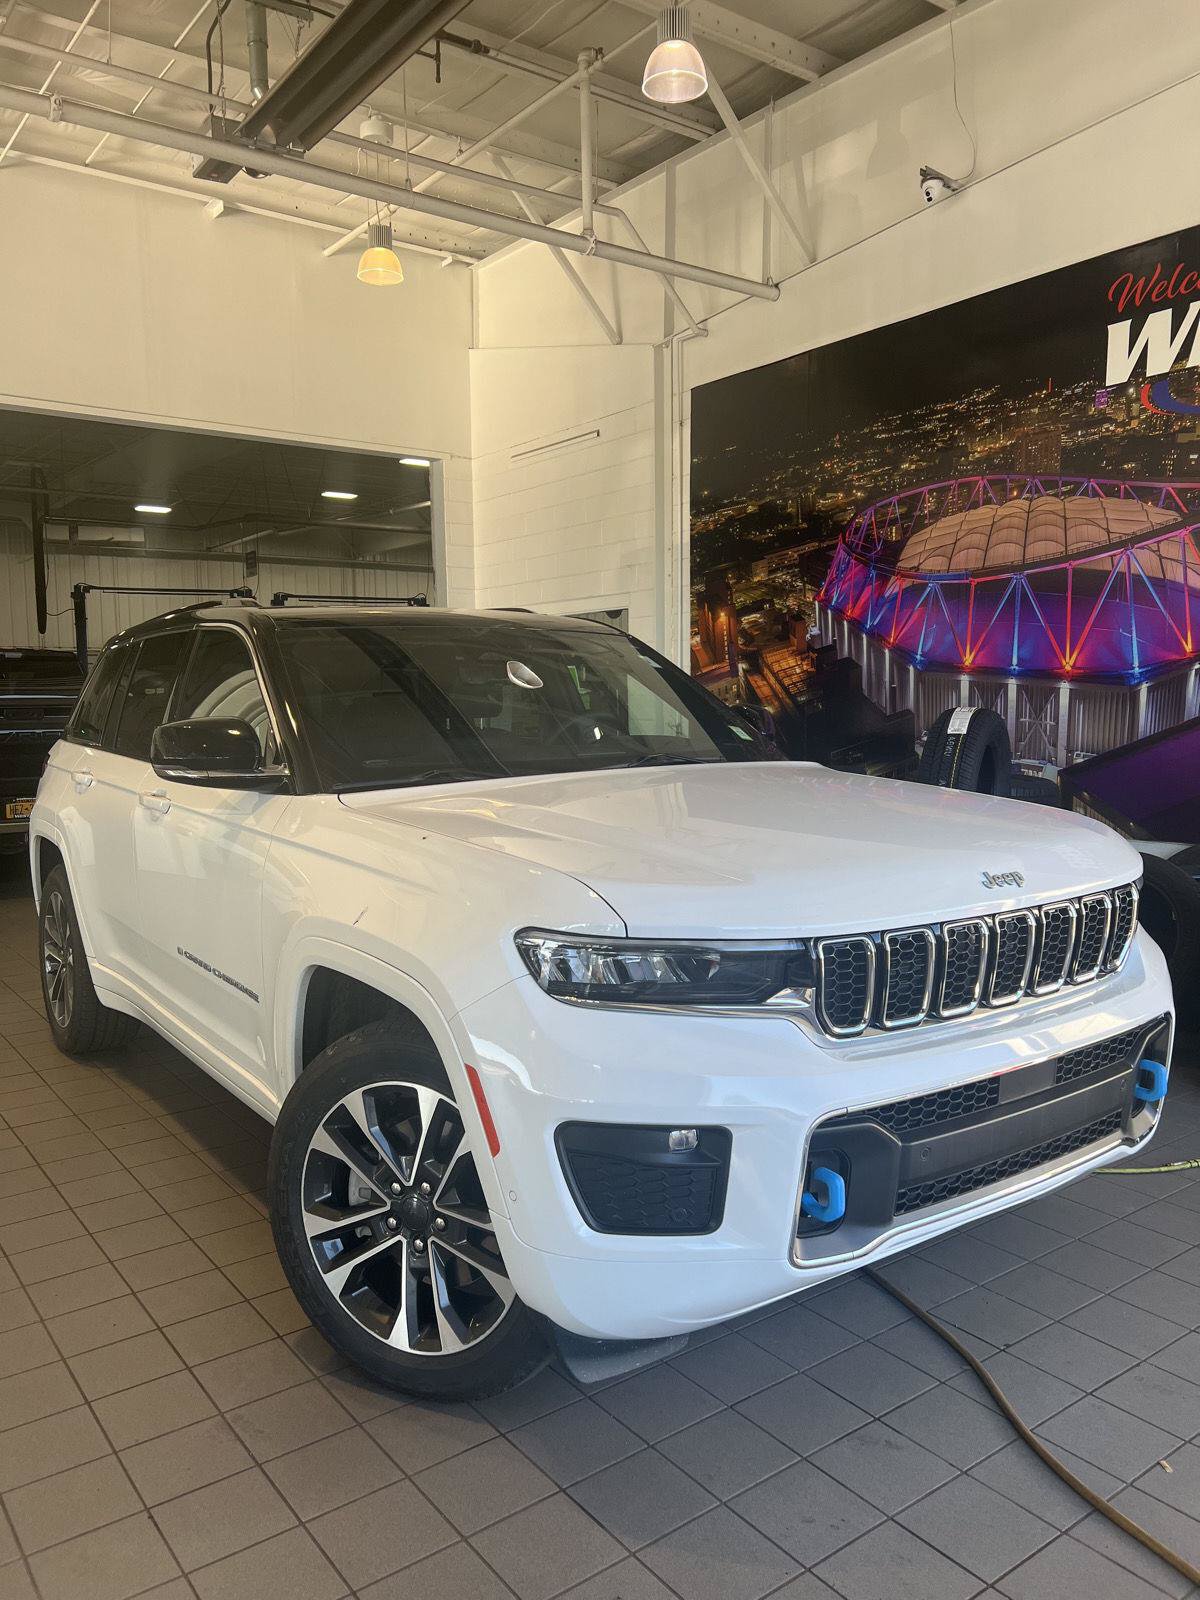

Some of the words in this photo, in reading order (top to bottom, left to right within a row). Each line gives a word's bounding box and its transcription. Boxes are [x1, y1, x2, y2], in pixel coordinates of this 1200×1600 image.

[1108, 263, 1200, 313] Welc
[1105, 300, 1200, 387] W
[981, 871, 1025, 889] Jeep
